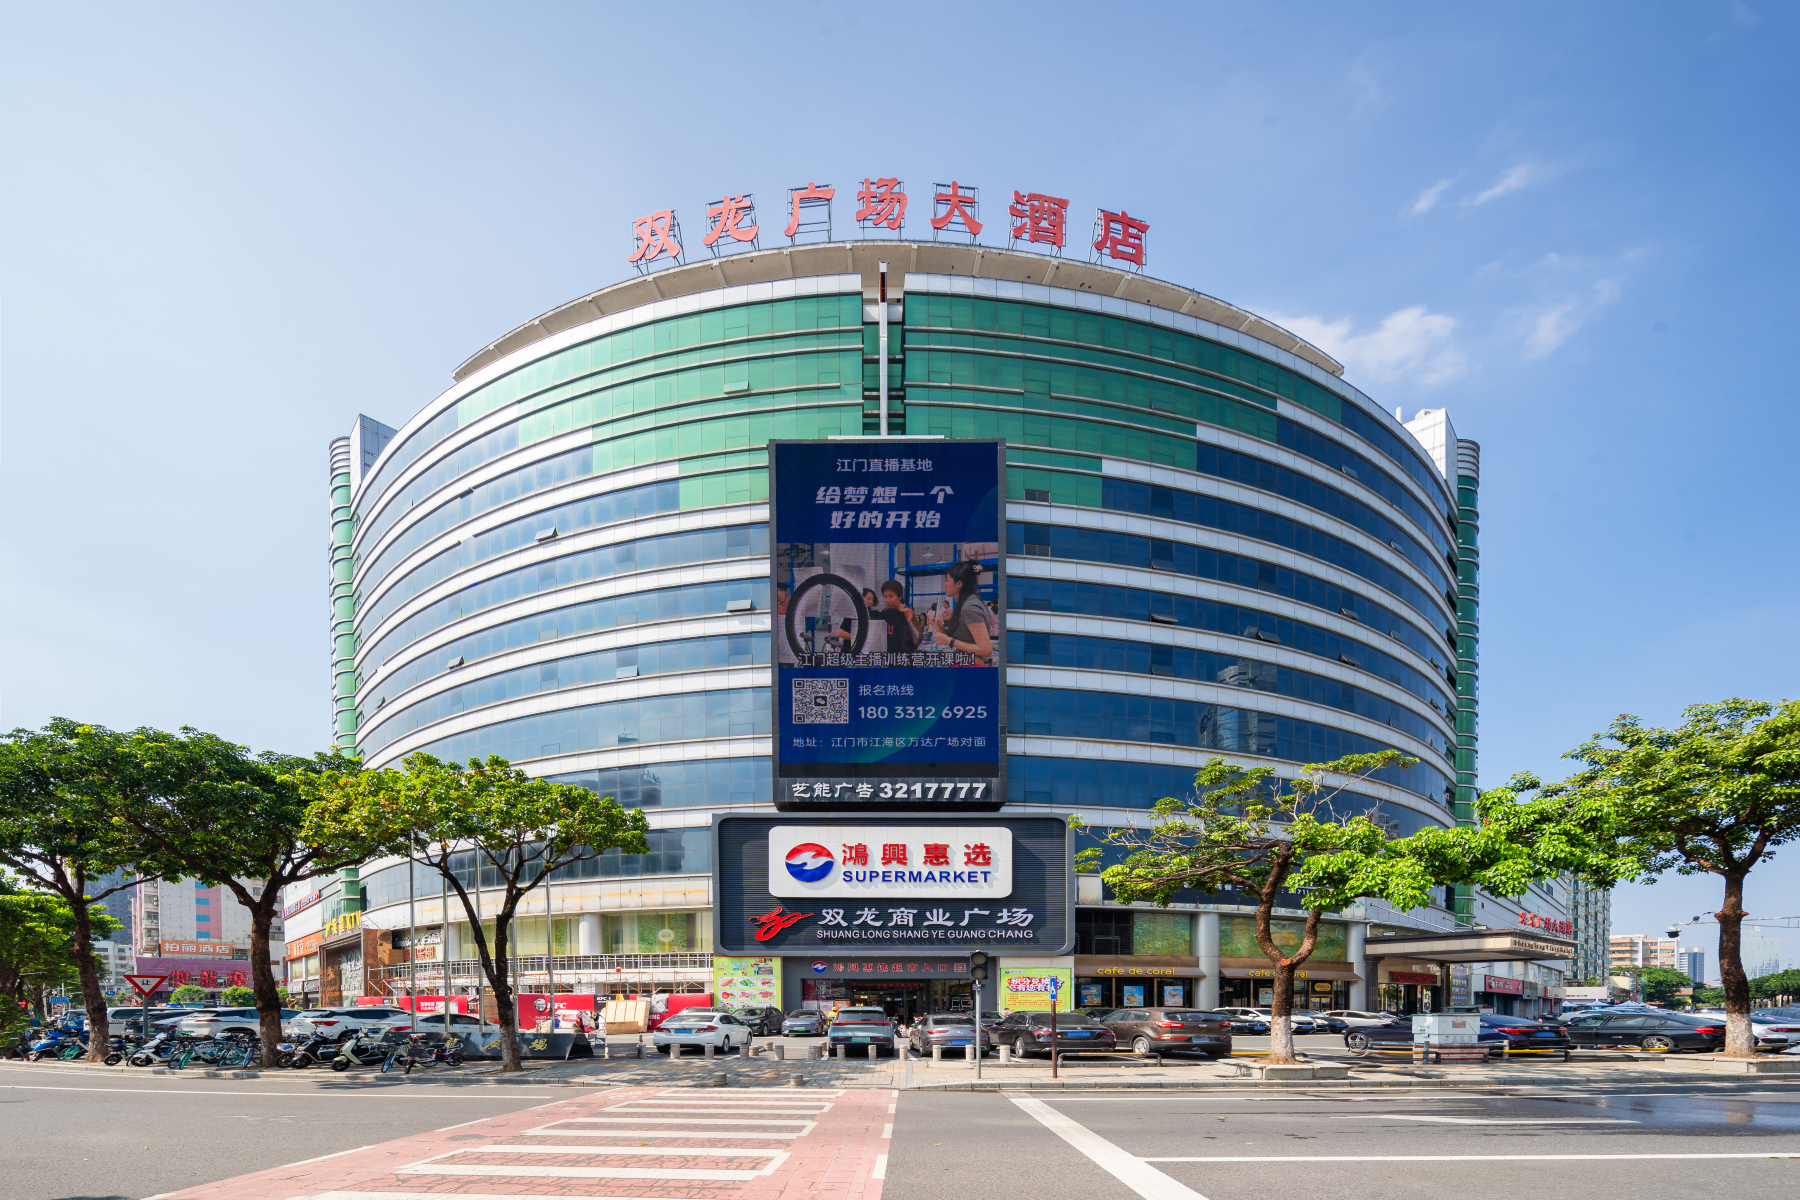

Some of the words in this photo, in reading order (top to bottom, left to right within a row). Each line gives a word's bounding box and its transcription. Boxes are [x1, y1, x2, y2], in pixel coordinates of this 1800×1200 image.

[628, 177, 1151, 267] 双龙广场大酒店
[836, 458, 933, 472] 江门直播基地
[815, 485, 954, 504] 给梦想一个
[830, 510, 941, 529] 好的开始
[858, 684, 914, 697] 报名热线
[858, 706, 888, 719] 180
[894, 706, 936, 719] 3312
[941, 706, 988, 719] 6925
[842, 870, 992, 883] SUPERMARKET
[817, 907, 1034, 927] 双龙商业广场
[816, 929, 860, 939] SHUANG
[862, 929, 890, 939] LONG
[892, 929, 930, 939] SHANG
[931, 929, 946, 939] YE
[948, 929, 986, 939] GUANG
[988, 929, 1033, 939] CHANG
[163, 943, 230, 954] 柏丽酒店
[1097, 966, 1125, 975] café
[1128, 967, 1144, 975] de
[1146, 967, 1176, 975] coral
[1248, 969, 1271, 977] café
